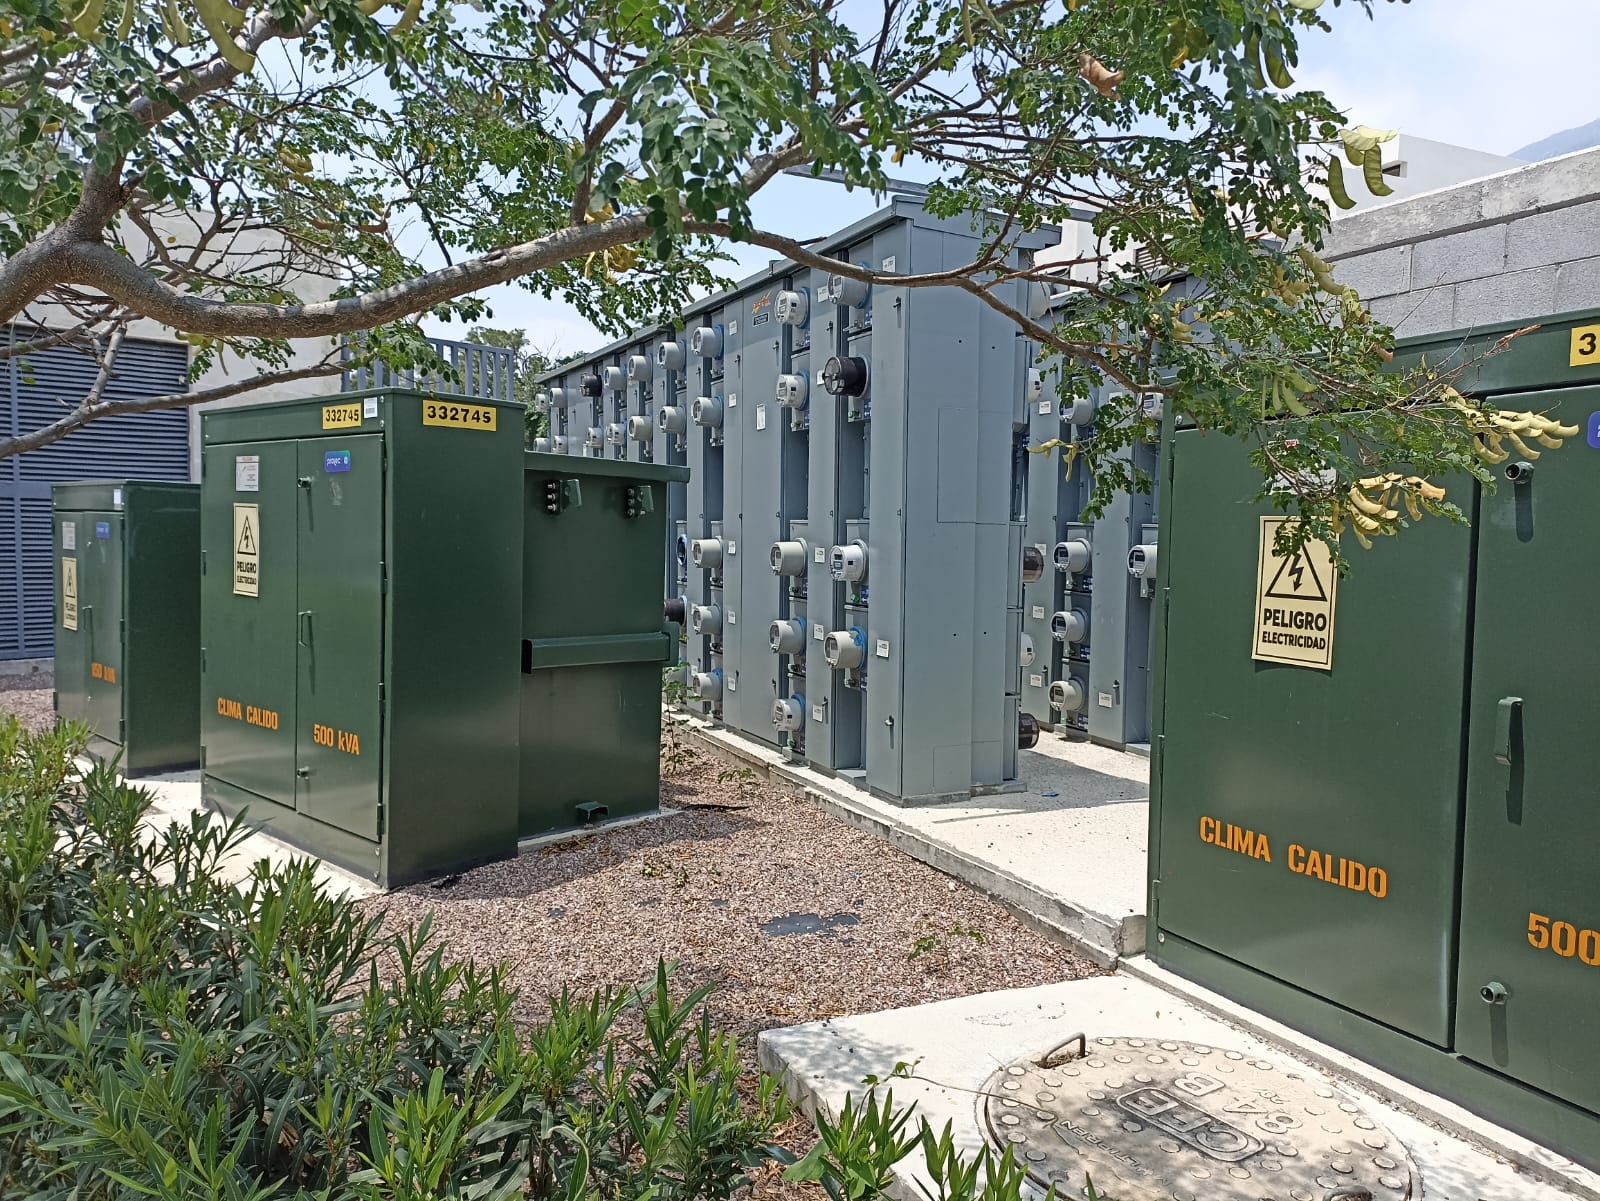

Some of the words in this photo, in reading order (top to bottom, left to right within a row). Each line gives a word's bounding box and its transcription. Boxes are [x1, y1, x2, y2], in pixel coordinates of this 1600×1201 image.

[325, 409, 359, 422] 332745
[427, 405, 492, 424] 332745
[236, 561, 257, 574] PELIGRO
[1263, 608, 1327, 632] PELIGRO
[1261, 631, 1326, 650] ELECTRICIDAD
[217, 697, 242, 720] CLIMA
[246, 705, 279, 731] CALIDO
[313, 723, 334, 747] 500
[338, 730, 360, 756] kVA
[1199, 815, 1271, 863] CLIMA
[1287, 843, 1388, 899] CALIDO
[1526, 911, 1600, 966] 500
[1174, 1072, 1226, 1098] B
[1124, 1089, 1249, 1153] CFE
[1222, 1096, 1303, 1134] 84
